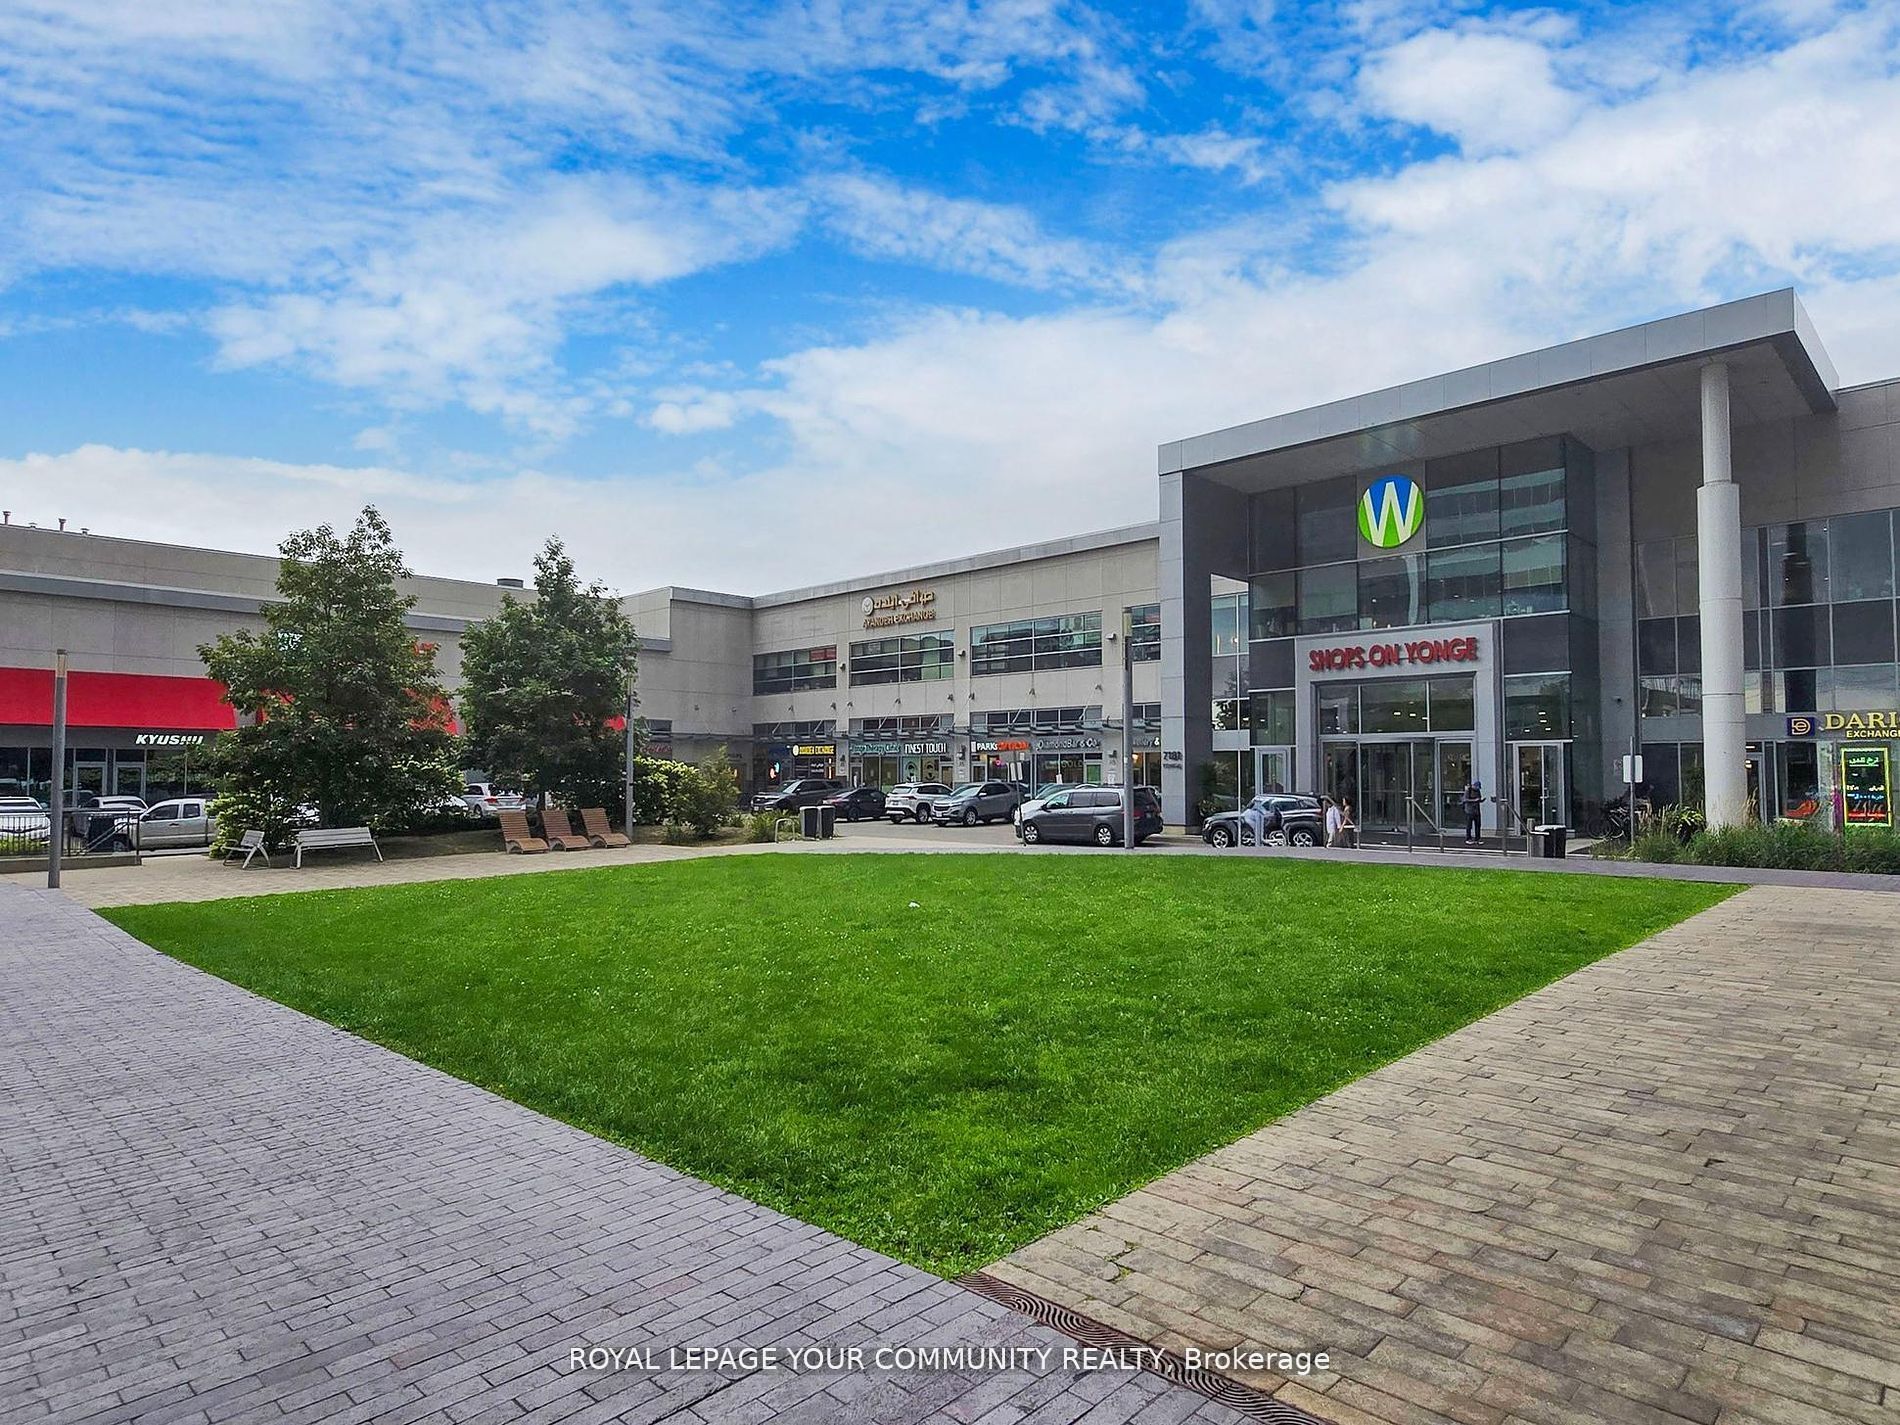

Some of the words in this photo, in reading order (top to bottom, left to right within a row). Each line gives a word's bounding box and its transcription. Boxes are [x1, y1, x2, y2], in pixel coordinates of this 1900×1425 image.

[1363, 481, 1419, 547] W
[894, 608, 936, 625] EXCHANGE
[1309, 646, 1366, 672] SHOPS
[1368, 644, 1400, 667] ON
[1404, 636, 1478, 664] YONGE
[905, 743, 925, 754] FINEST
[926, 742, 948, 754] TOUCH
